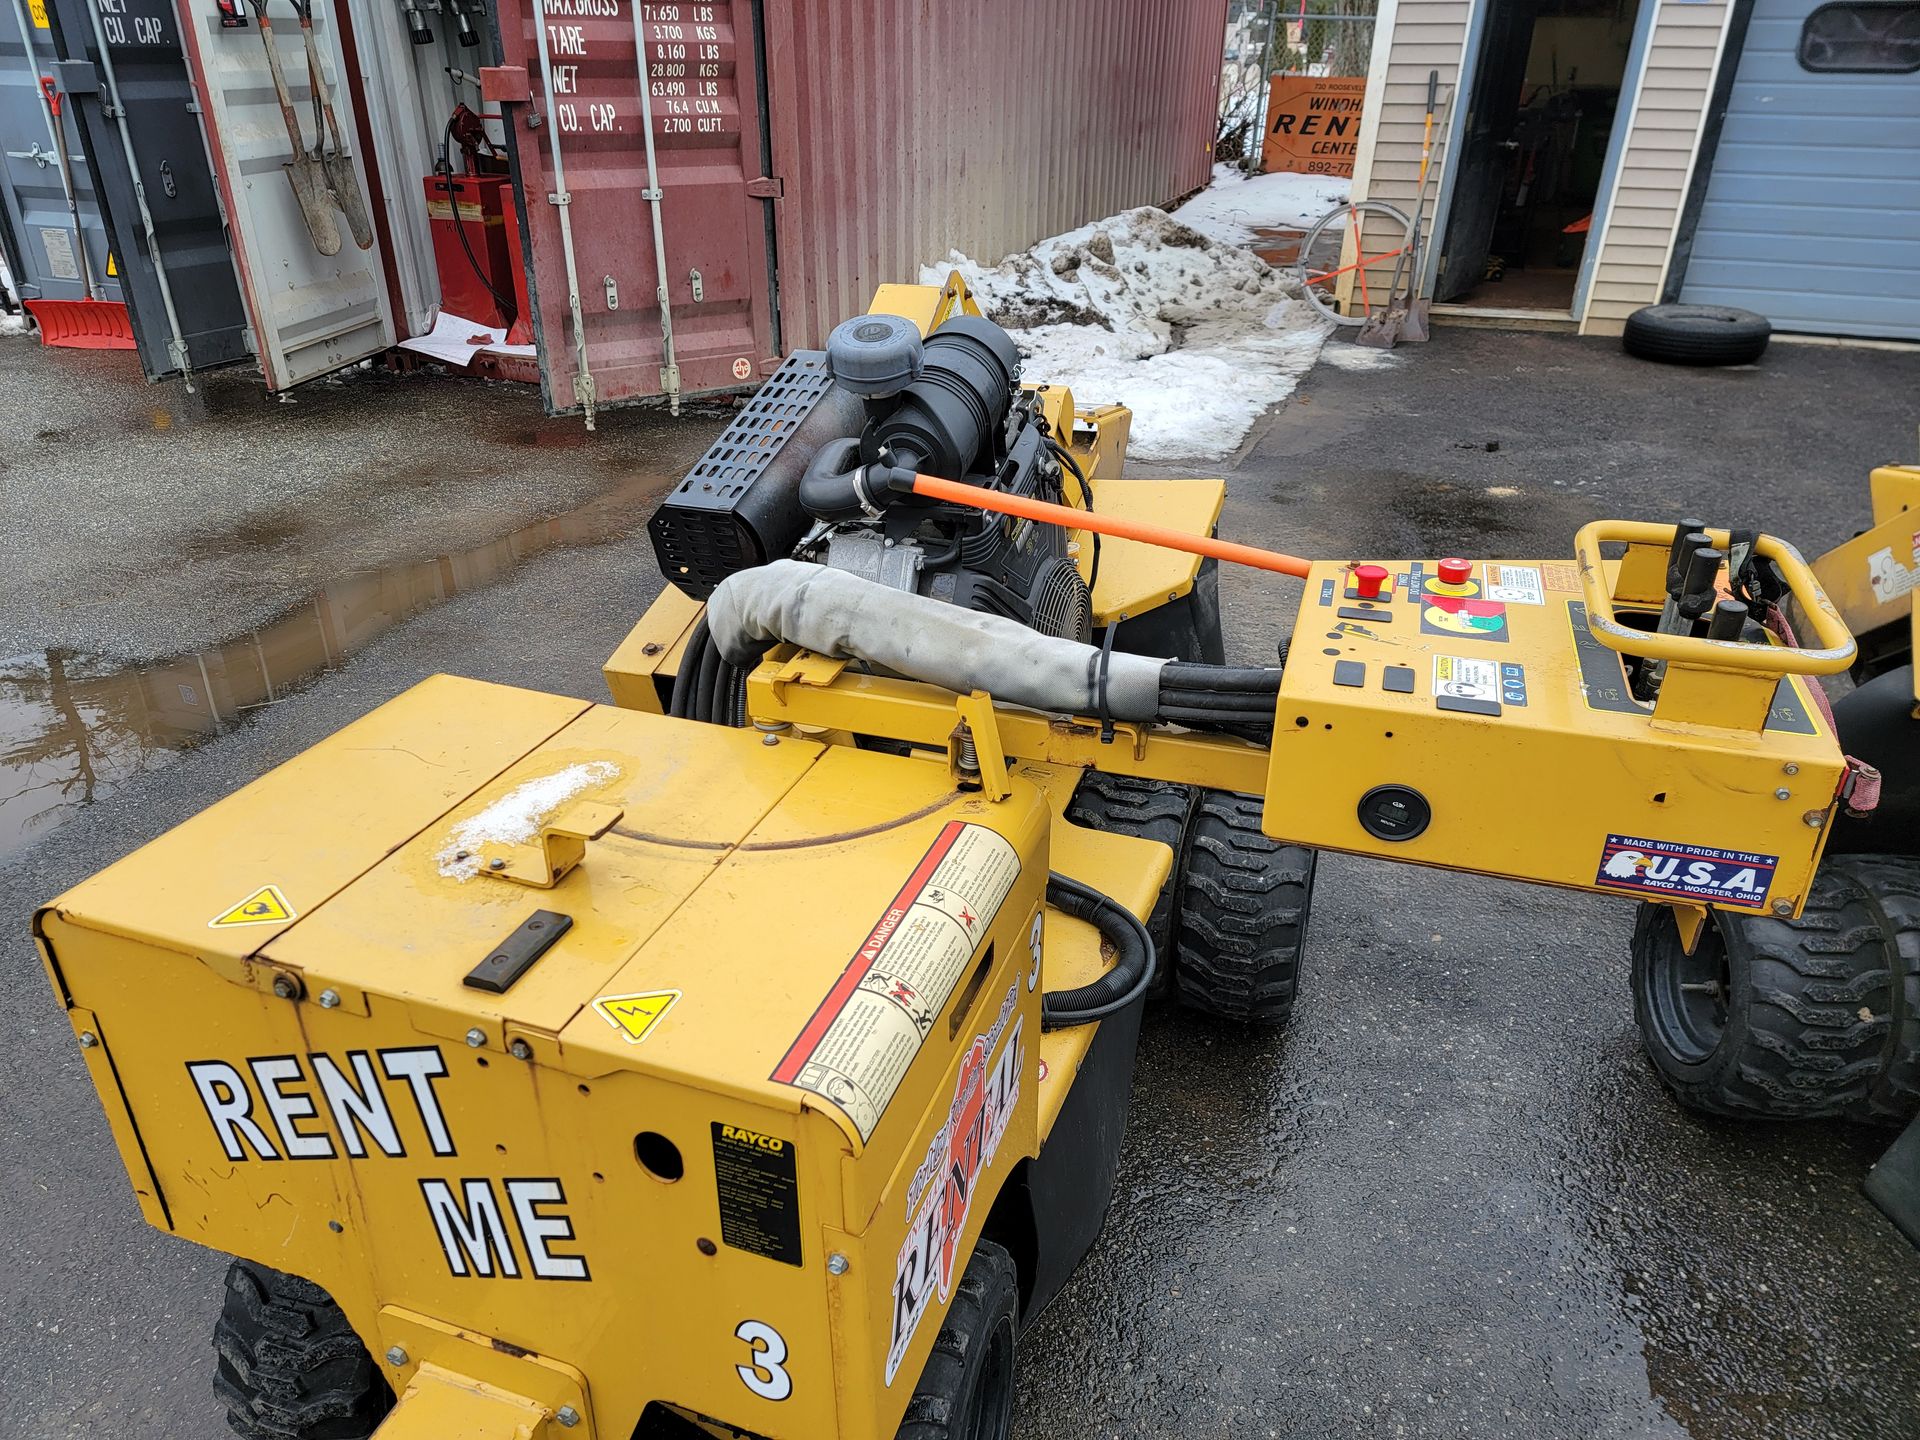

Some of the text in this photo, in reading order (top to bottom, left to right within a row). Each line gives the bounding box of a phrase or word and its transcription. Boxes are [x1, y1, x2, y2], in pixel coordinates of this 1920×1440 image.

[693, 6, 713, 22] LBS
[103, 17, 170, 44] CU. CAP.
[548, 26, 587, 55] TARE
[654, 25, 717, 40] 3.700 KGS
[657, 44, 719, 60] 8.160 LBS
[553, 66, 578, 94] NET
[651, 63, 719, 77] 28.800 KGS
[652, 82, 718, 96] 63.490 LBS
[666, 100, 689, 114] 76.4
[1309, 97, 1363, 112] WINDH
[559, 104, 622, 132] CU. CAP.
[664, 118, 691, 133] 2.700
[1623, 838, 1760, 863] MADE WITH PRIDE IN THE
[1645, 855, 1766, 894] U.S.A.
[1643, 879, 1762, 901] RAYCO WOOSTER, OHIO
[868, 907, 905, 950] DANGER
[1027, 911, 1043, 993] 3
[186, 1045, 458, 1162] RENT
[722, 1125, 783, 1151] RAYCO
[418, 1177, 592, 1281] ME
[735, 1320, 794, 1402] 3
